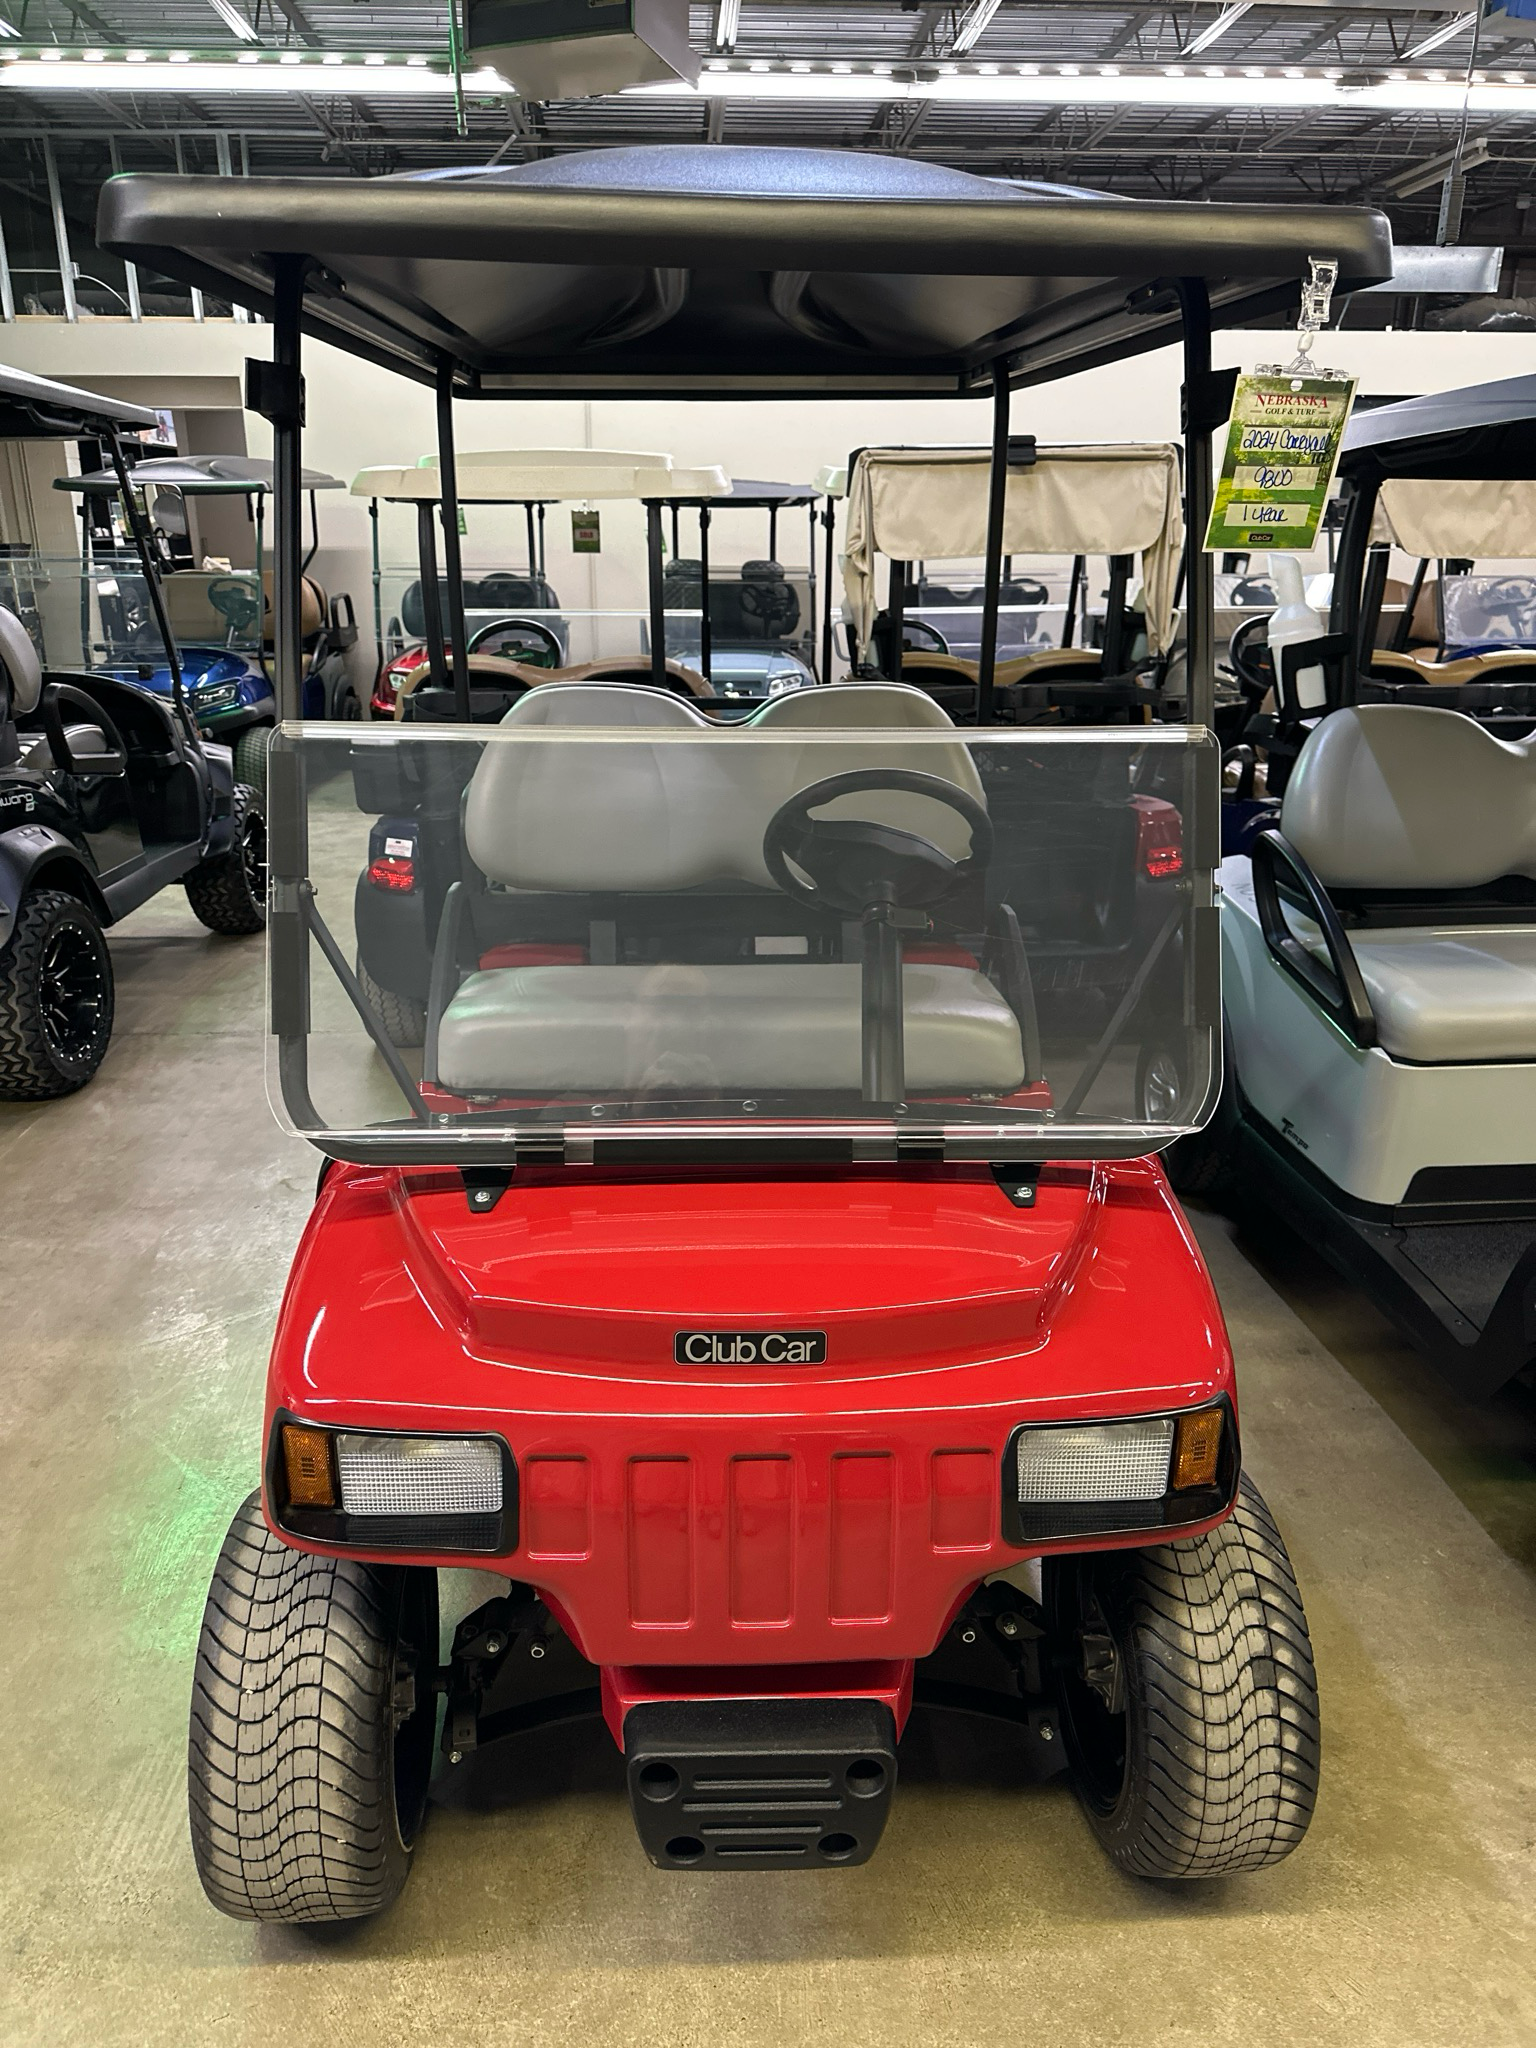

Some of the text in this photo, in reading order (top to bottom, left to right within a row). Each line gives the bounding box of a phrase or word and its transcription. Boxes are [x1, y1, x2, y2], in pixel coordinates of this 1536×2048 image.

[1255, 394, 1328, 408] NEBRASKA
[1265, 407, 1287, 415] GOLF
[1295, 408, 1317, 416] TURF
[1243, 429, 1280, 451] 2024
[1254, 466, 1293, 489] 9800
[1243, 505, 1248, 521] 1
[1281, 1116, 1309, 1150] Tempo
[685, 1333, 817, 1363] Club Car
